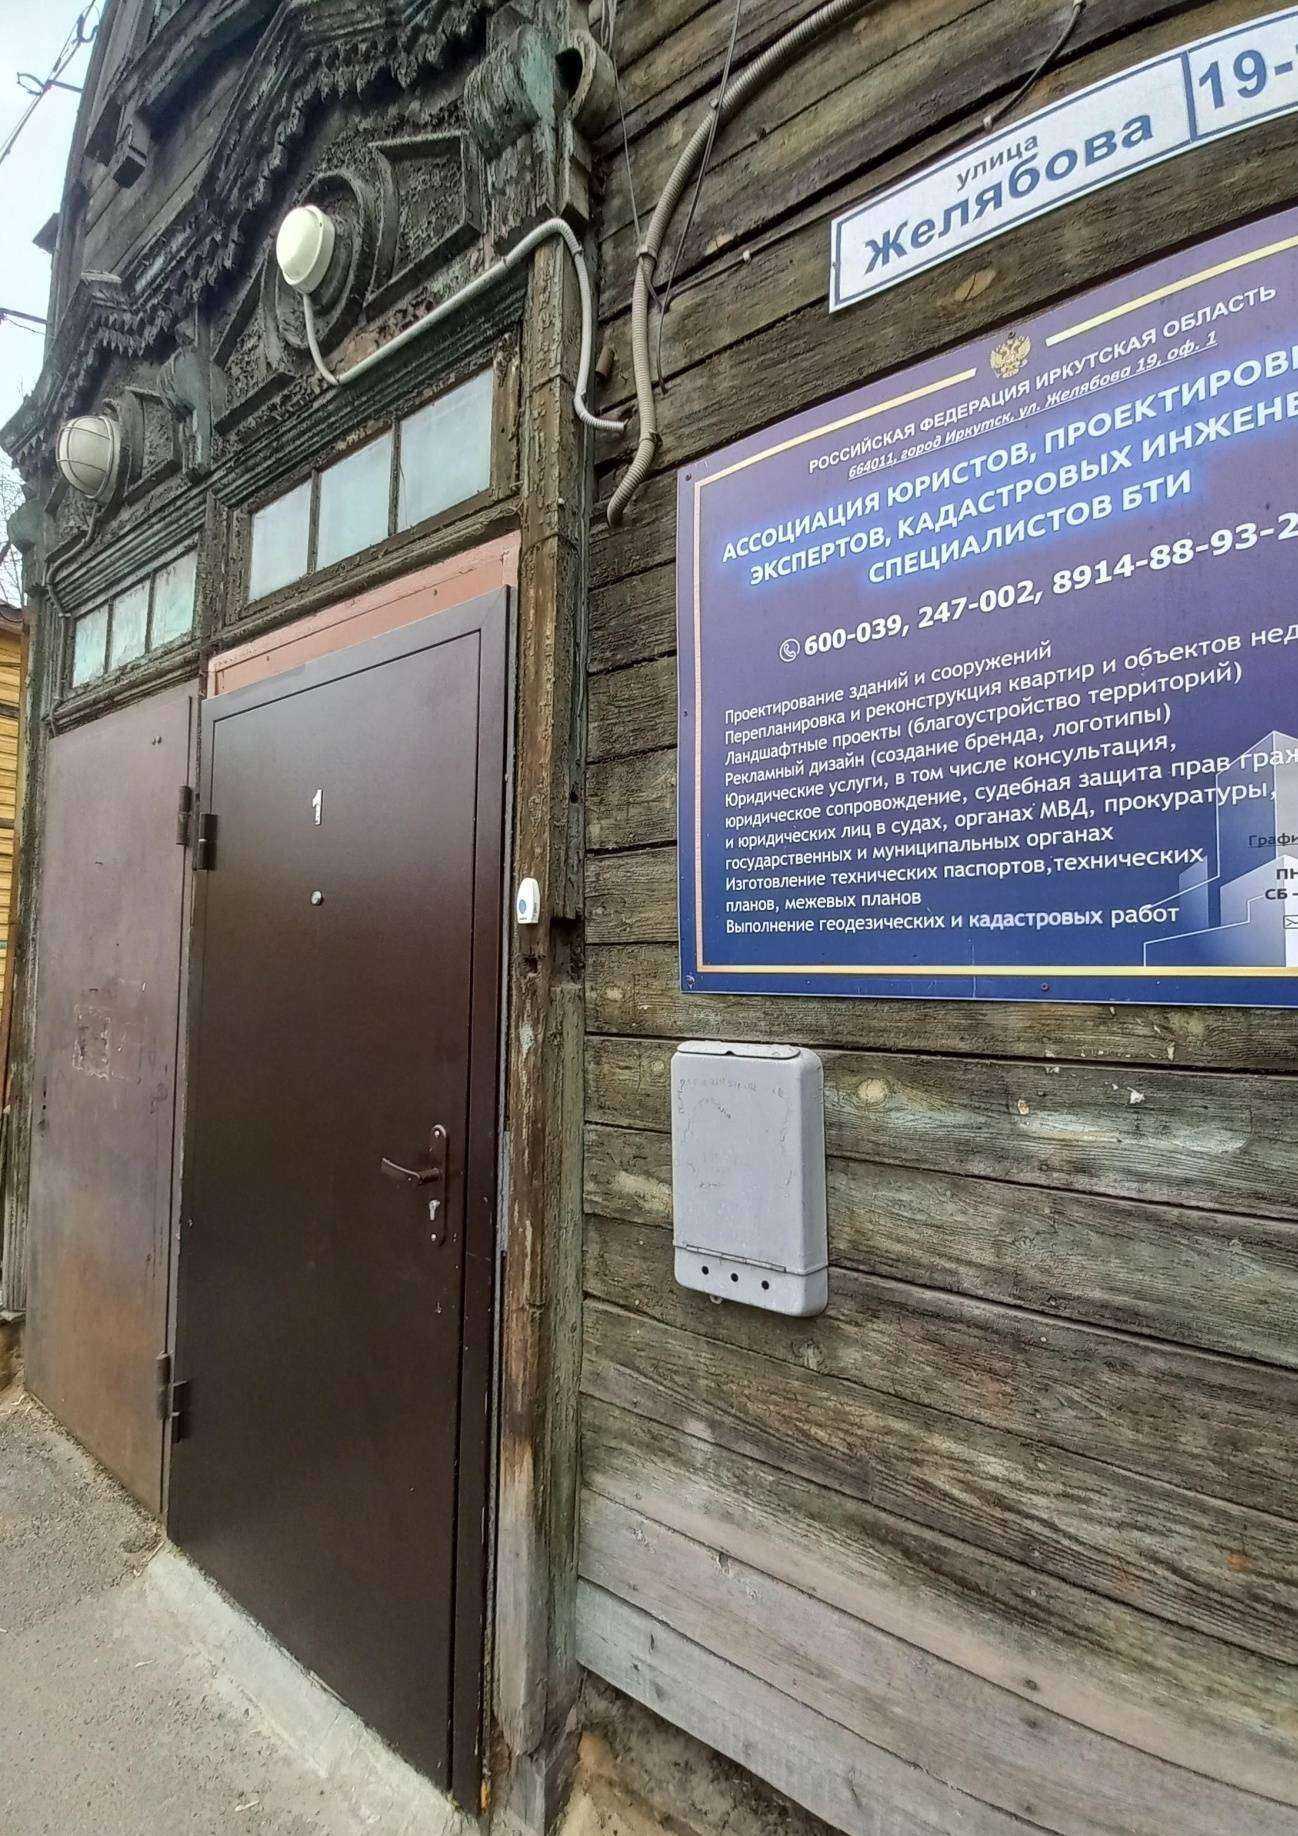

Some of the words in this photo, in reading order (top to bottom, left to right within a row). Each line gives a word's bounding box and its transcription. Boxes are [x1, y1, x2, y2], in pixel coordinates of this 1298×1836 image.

[1199, 45, 1298, 110] 19-
[864, 114, 1154, 276] Желябова
[957, 135, 1038, 192] улица
[809, 423, 915, 474] РОССИЙСКАЯ
[919, 380, 1030, 432] ФЕДЕРАЦИЯ
[1035, 328, 1157, 391] ИРКУТСКАЯ
[1162, 286, 1277, 338] ОБЛАСТЬ
[849, 452, 898, 479] 664011,
[901, 434, 942, 460] город
[944, 411, 1015, 443] Иркутск,
[1019, 400, 1040, 421] ул.
[1045, 366, 1131, 408] Желябова
[1136, 353, 1162, 373] 19,
[1167, 339, 1199, 361] оф.
[1207, 330, 1217, 345] 1
[722, 491, 880, 562] АССОЦИАЦИЯ
[887, 442, 1037, 507] ЮРИСТОВ,
[1045, 345, 1298, 454] ПРОЕКТИРОВ
[750, 527, 892, 585] ЭКСПЕРТОВ,
[898, 445, 1133, 539] КАДАСТРОВЫХ
[868, 495, 1113, 583] СПЕЦИАЛИСТОВ
[1122, 469, 1192, 511] БТИ
[804, 614, 909, 656] 600-039,
[918, 580, 1044, 628] 247-002,
[1053, 512, 1298, 594] 8914-88-93-2
[725, 689, 844, 724] Проектирование
[849, 671, 908, 699] зданий
[914, 672, 925, 685] и
[931, 639, 1051, 682] сооружений
[725, 711, 845, 745] Перепланировка
[851, 708, 860, 722] и
[866, 681, 1001, 721] реконструкция
[1008, 663, 1095, 692] квартир
[1102, 658, 1116, 674] и
[1124, 634, 1241, 669] объектов
[725, 738, 827, 766] Ландшафтные
[832, 725, 901, 749] проекты
[908, 692, 1081, 738] (благоустройство
[1088, 661, 1242, 704] территорий)
[725, 760, 804, 786] Рекламный
[809, 752, 864, 776] дизайн
[870, 740, 959, 768] (создание
[964, 727, 1044, 753] бренда,
[1052, 703, 1171, 738] логотипы)
[725, 783, 824, 809] Юридические
[828, 775, 889, 797] услуги,
[895, 772, 905, 785] в
[910, 767, 944, 783] том
[949, 758, 1007, 778] числе
[1013, 733, 1177, 769] консультация,
[312, 789, 322, 825] 1
[725, 806, 821, 830] юридическое
[826, 789, 967, 817] сопровождение,
[975, 775, 1071, 803] судебная
[1078, 765, 1162, 788] защита
[1171, 756, 1230, 779] прав
[725, 838, 734, 849] и
[738, 827, 836, 850] юридических
[841, 824, 871, 839] лиц
[876, 822, 885, 835] в
[891, 815, 948, 836] судах,
[955, 807, 1033, 830] органах
[1040, 797, 1095, 820] МВД,
[1104, 782, 1276, 815] прокуратуры,
[725, 849, 851, 871] государственных
[857, 848, 867, 860] и
[872, 834, 1020, 861] муниципальных
[1026, 825, 1114, 849] органах
[725, 874, 826, 891] Изготовление
[831, 865, 937, 885] технических
[726, 898, 780, 914] планов,
[785, 895, 857, 910] межевых
[861, 892, 922, 906] планов
[726, 918, 815, 934] Выполнение
[819, 915, 945, 933] геодезических
[951, 915, 963, 928] и
[969, 910, 1104, 930] кадастровых
[1111, 905, 1179, 927] работ
[1265, 888, 1288, 900] СБ
